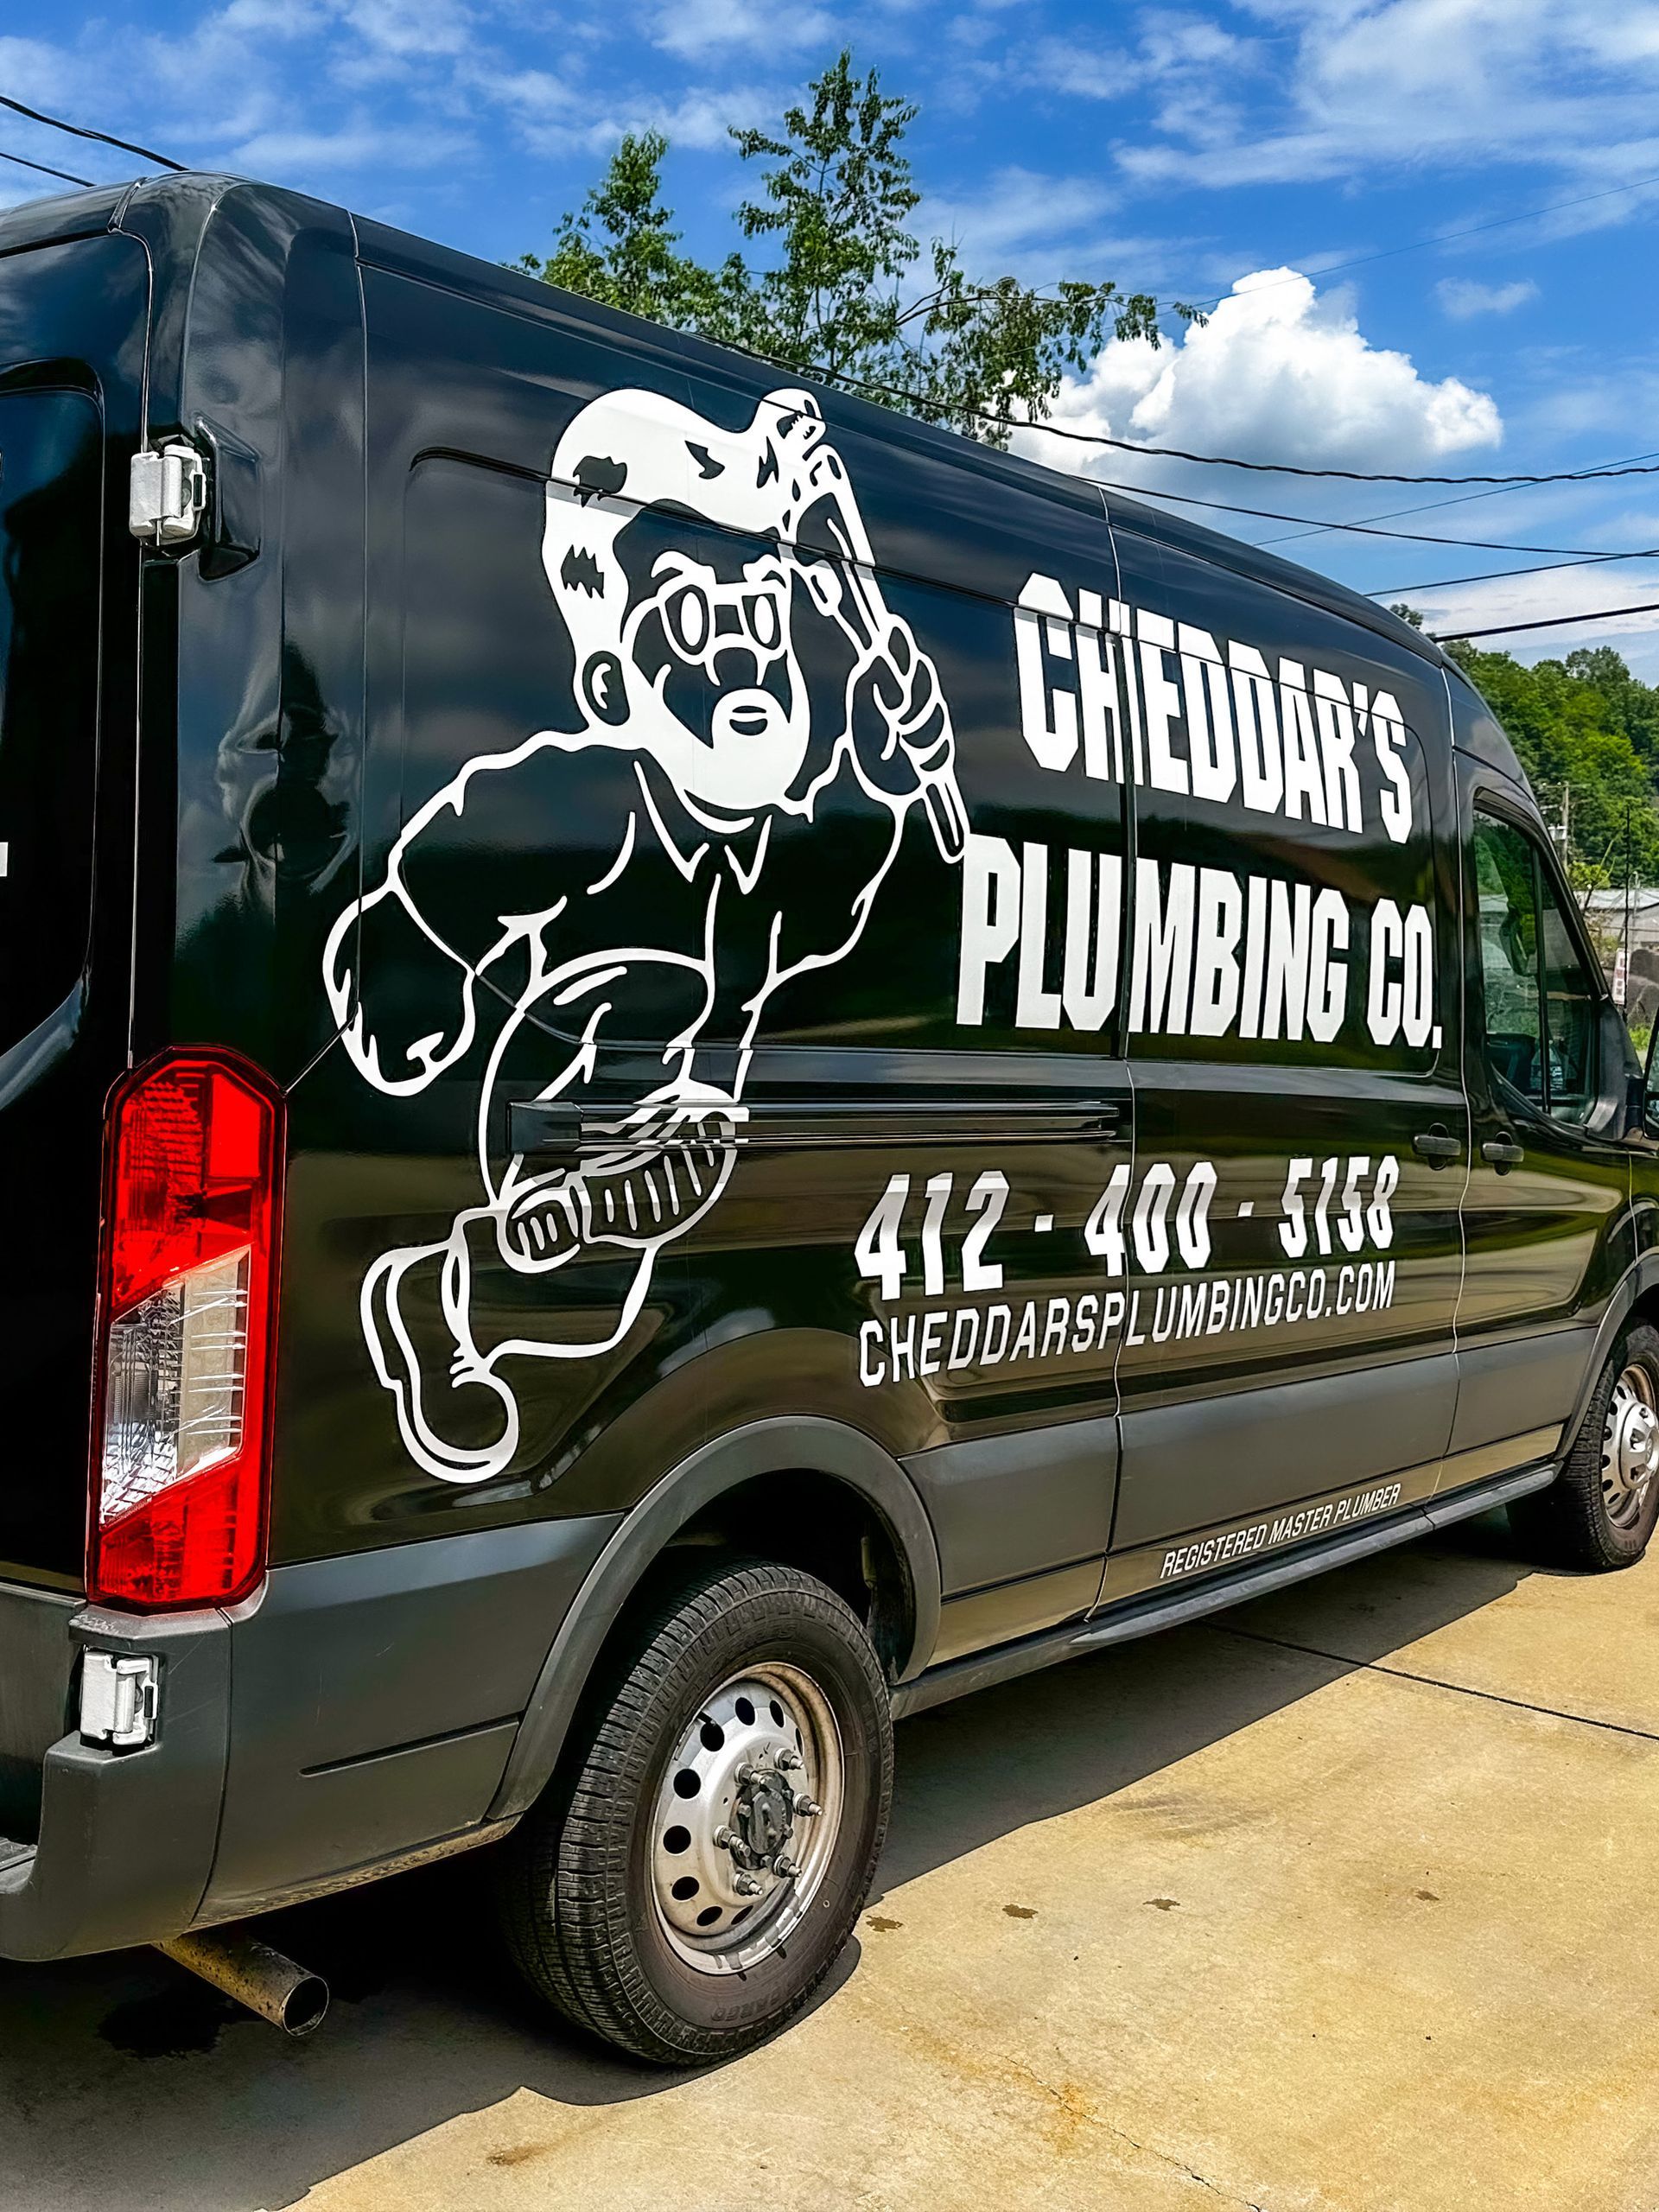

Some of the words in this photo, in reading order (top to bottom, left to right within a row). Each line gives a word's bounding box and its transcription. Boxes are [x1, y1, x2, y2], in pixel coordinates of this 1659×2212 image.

[1014, 572, 1413, 843] CHEDDAR'S
[957, 834, 1350, 1043] PLUMBING
[1367, 898, 1442, 1049] CO.
[854, 1170, 1010, 1300] 412
[1084, 1161, 1217, 1277] 400
[1277, 1155, 1400, 1259] 5158
[859, 1261, 1395, 1387] CHEDDARSPLUMBINGCO.COM
[1160, 1524, 1268, 1579] REGISTERED
[1268, 1503, 1333, 1545] MASTER
[1332, 1483, 1402, 1524] PLUMBER
